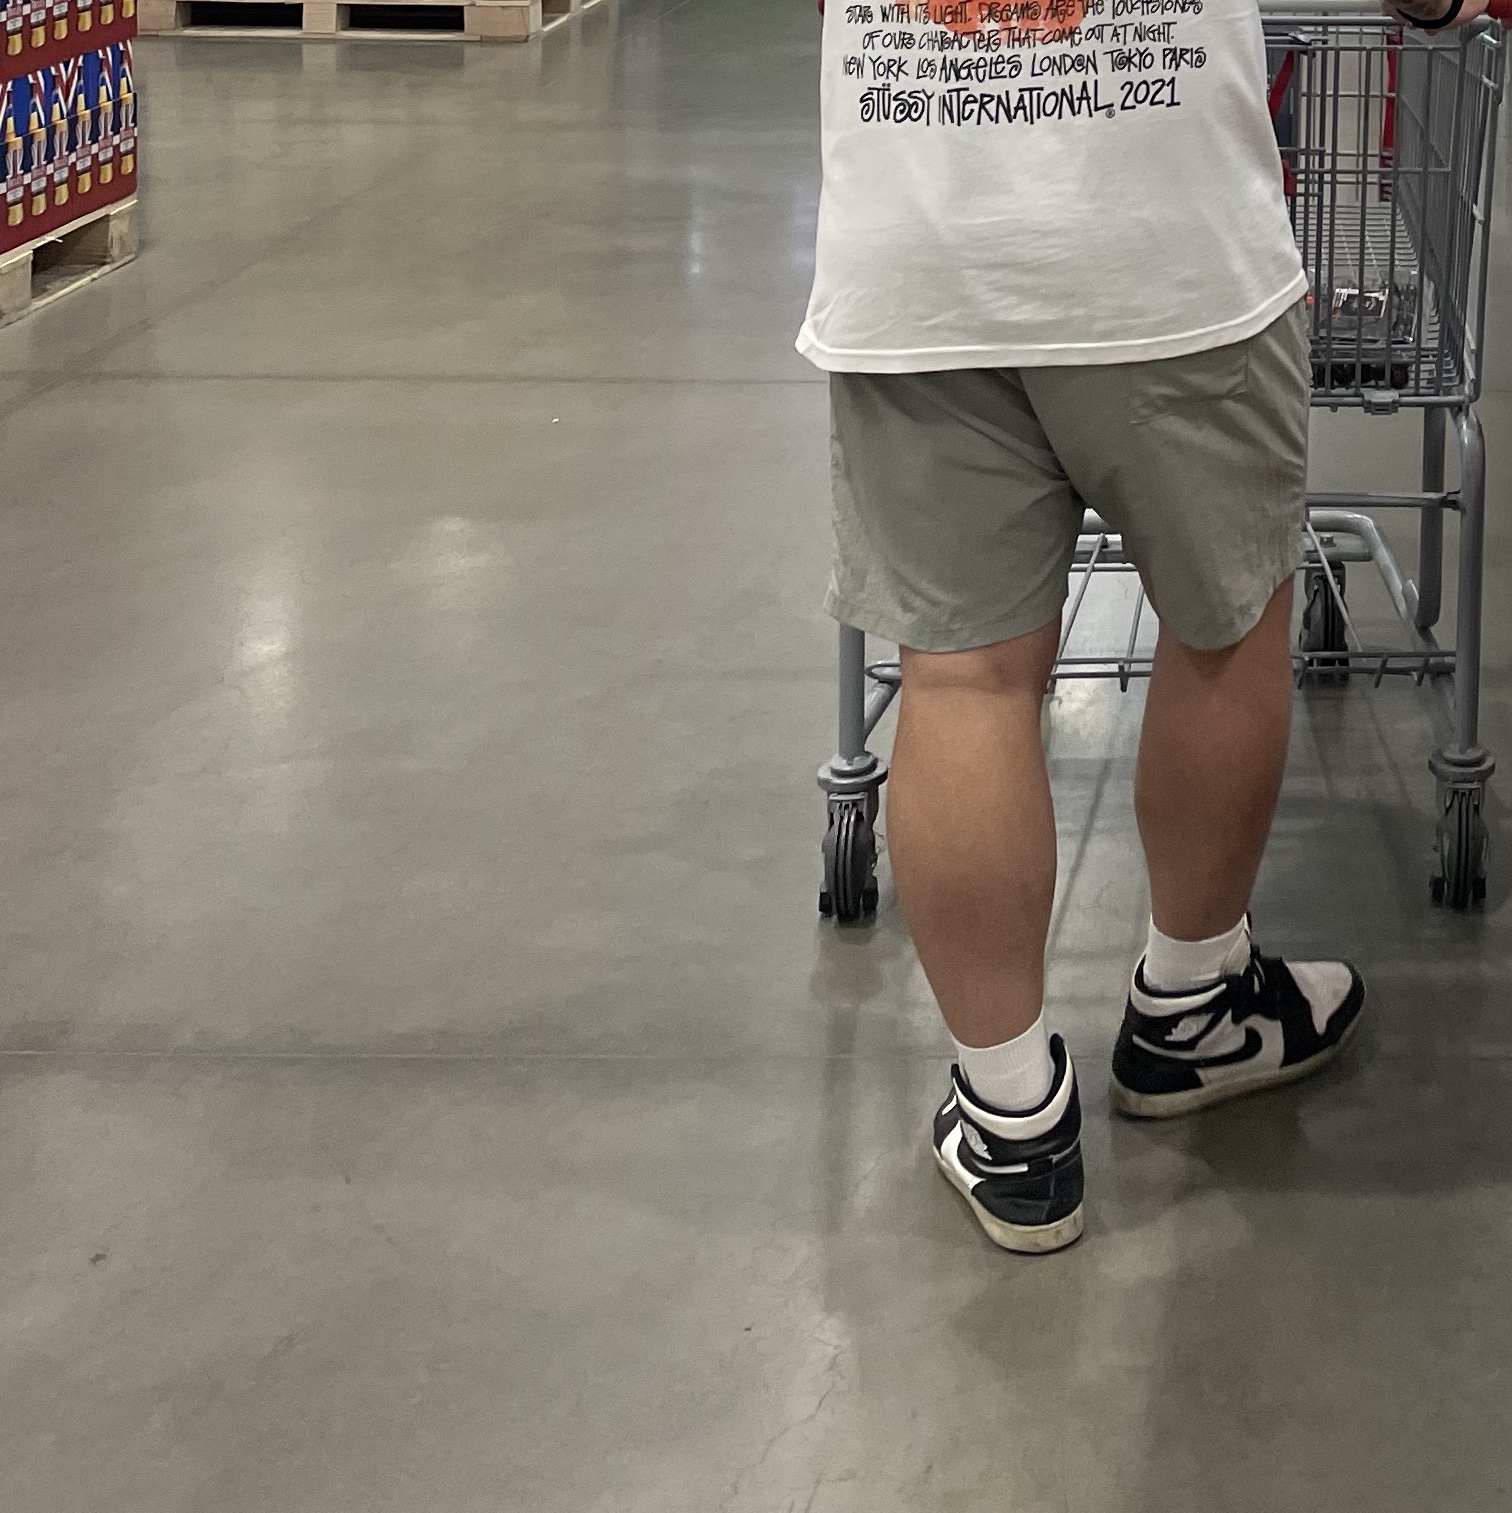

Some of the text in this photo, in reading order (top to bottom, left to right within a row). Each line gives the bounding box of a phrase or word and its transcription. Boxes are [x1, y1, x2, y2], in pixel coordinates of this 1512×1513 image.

[880, 0, 911, 25] WITH
[914, 0, 931, 25] ITS
[933, 0, 974, 25] LIGHT.
[862, 29, 884, 50] OF
[1002, 26, 1046, 50] THAT
[1041, 27, 1083, 48] COME
[1085, 23, 1115, 44] OUT
[1110, 22, 1136, 45] AT
[1133, 21, 1178, 44] NIGHT.
[843, 46, 1207, 83] NEW YORK LOS ANGELES LONDON TOKYO PARIS
[1120, 76, 1182, 112] 2021
